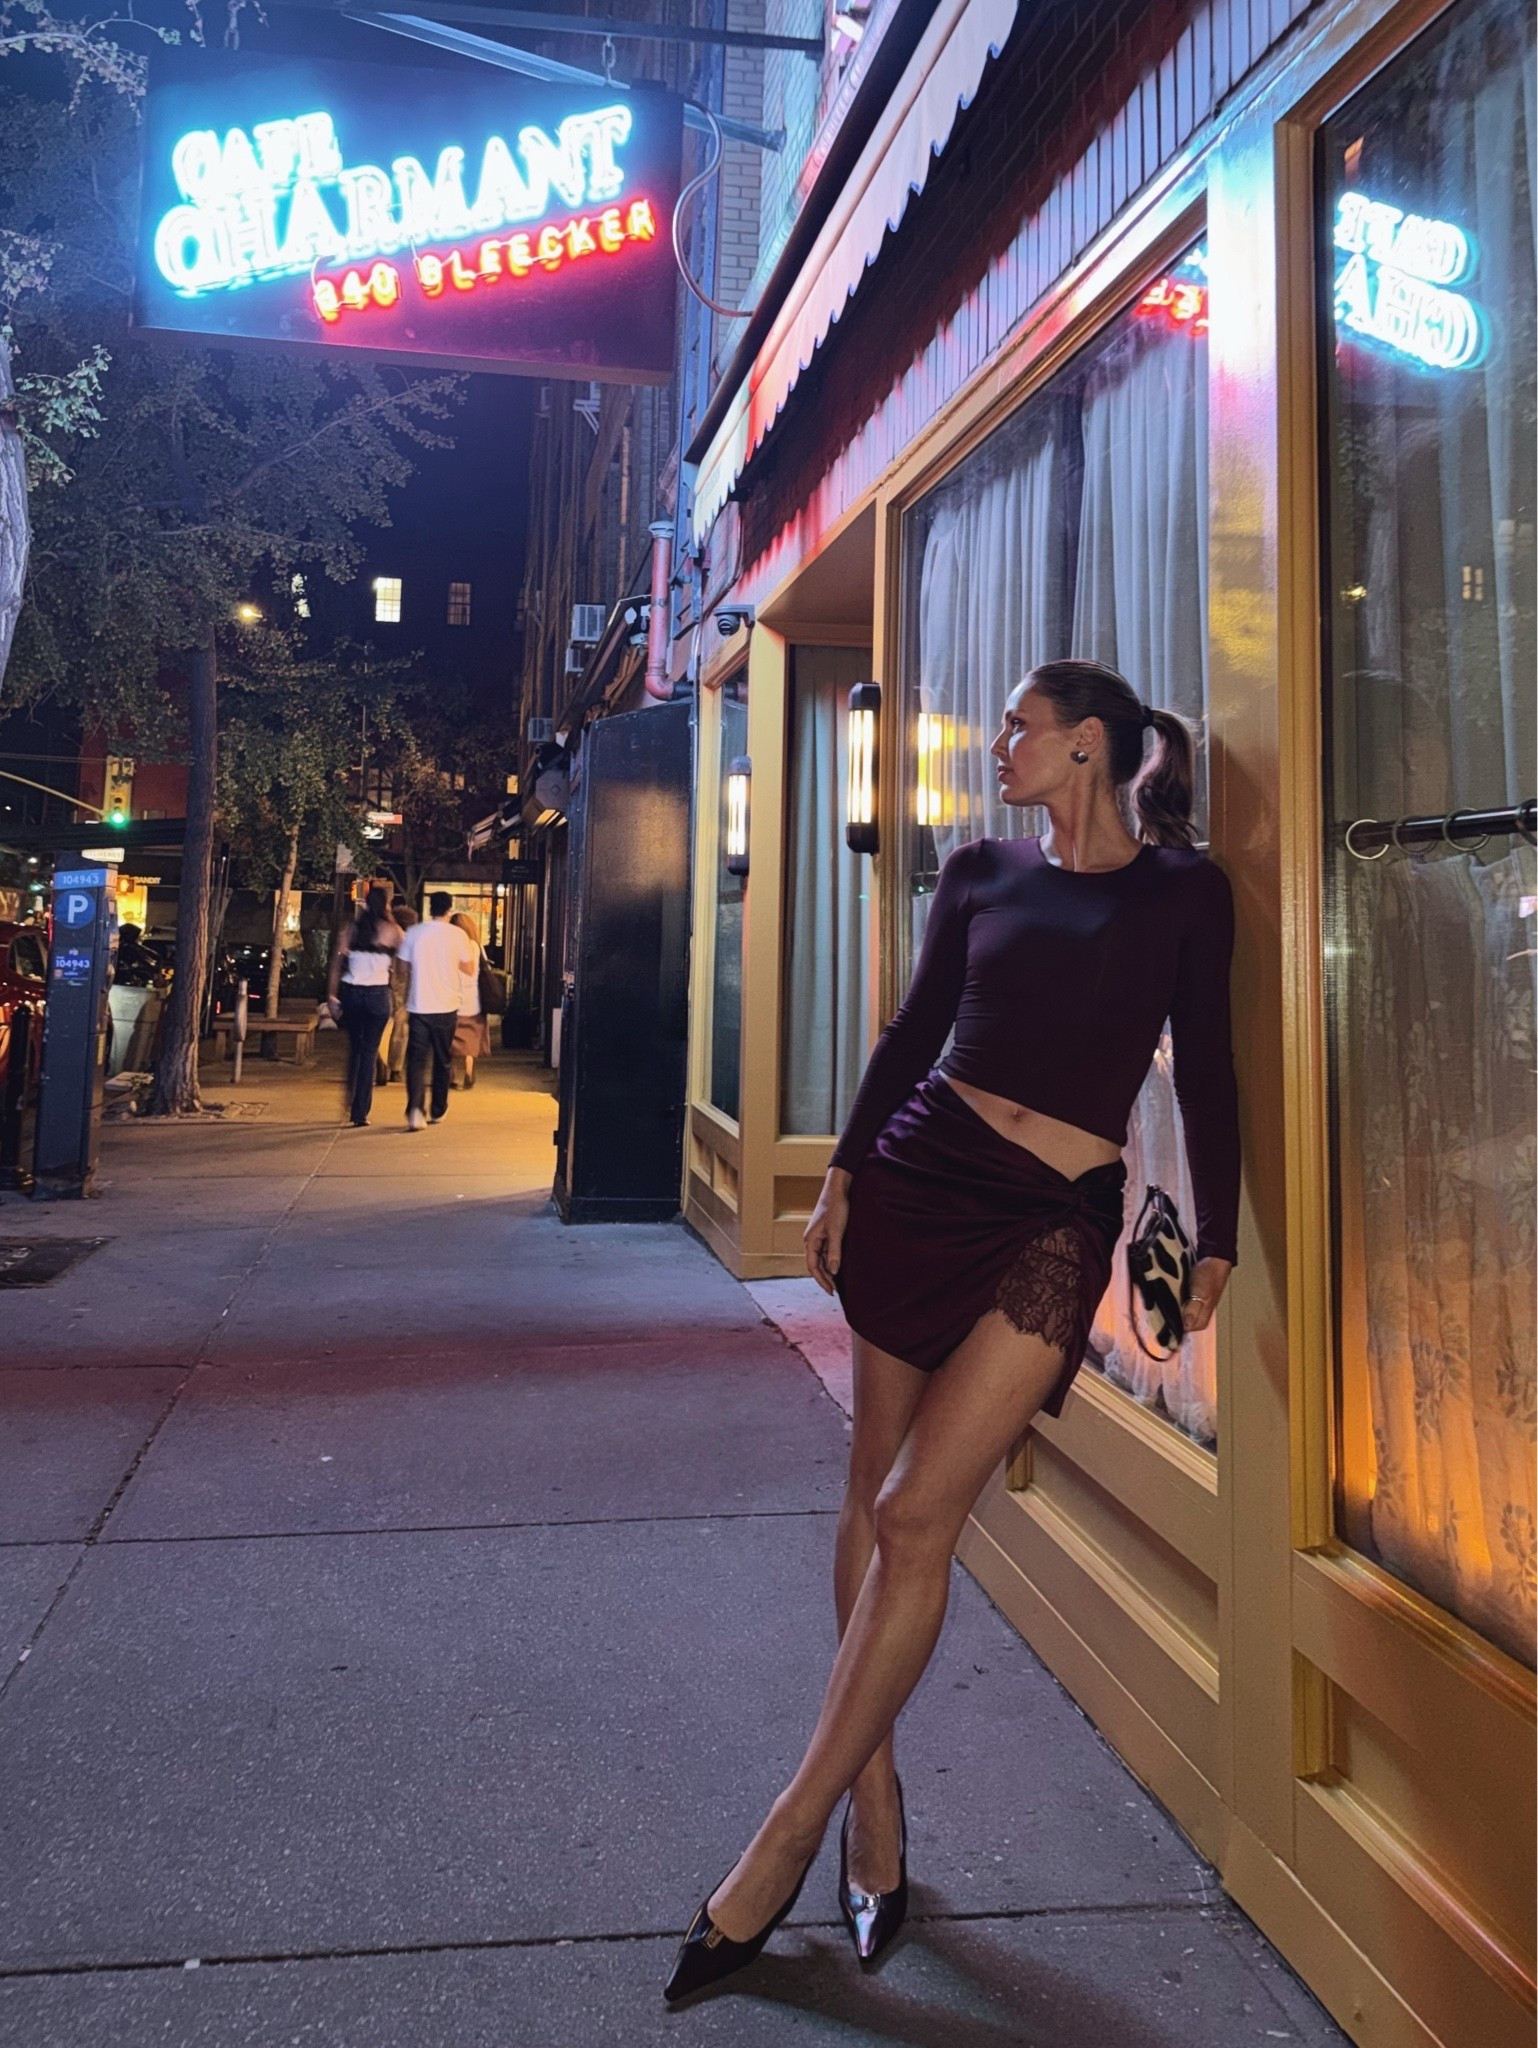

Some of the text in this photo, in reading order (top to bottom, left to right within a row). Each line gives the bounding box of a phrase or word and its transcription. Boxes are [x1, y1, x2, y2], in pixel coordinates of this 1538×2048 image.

[155, 105, 632, 294] CHARMANT
[417, 200, 656, 296] BLEECKER
[63, 874, 99, 884] 104943
[68, 895, 88, 923] P
[56, 959, 90, 968] 104943
